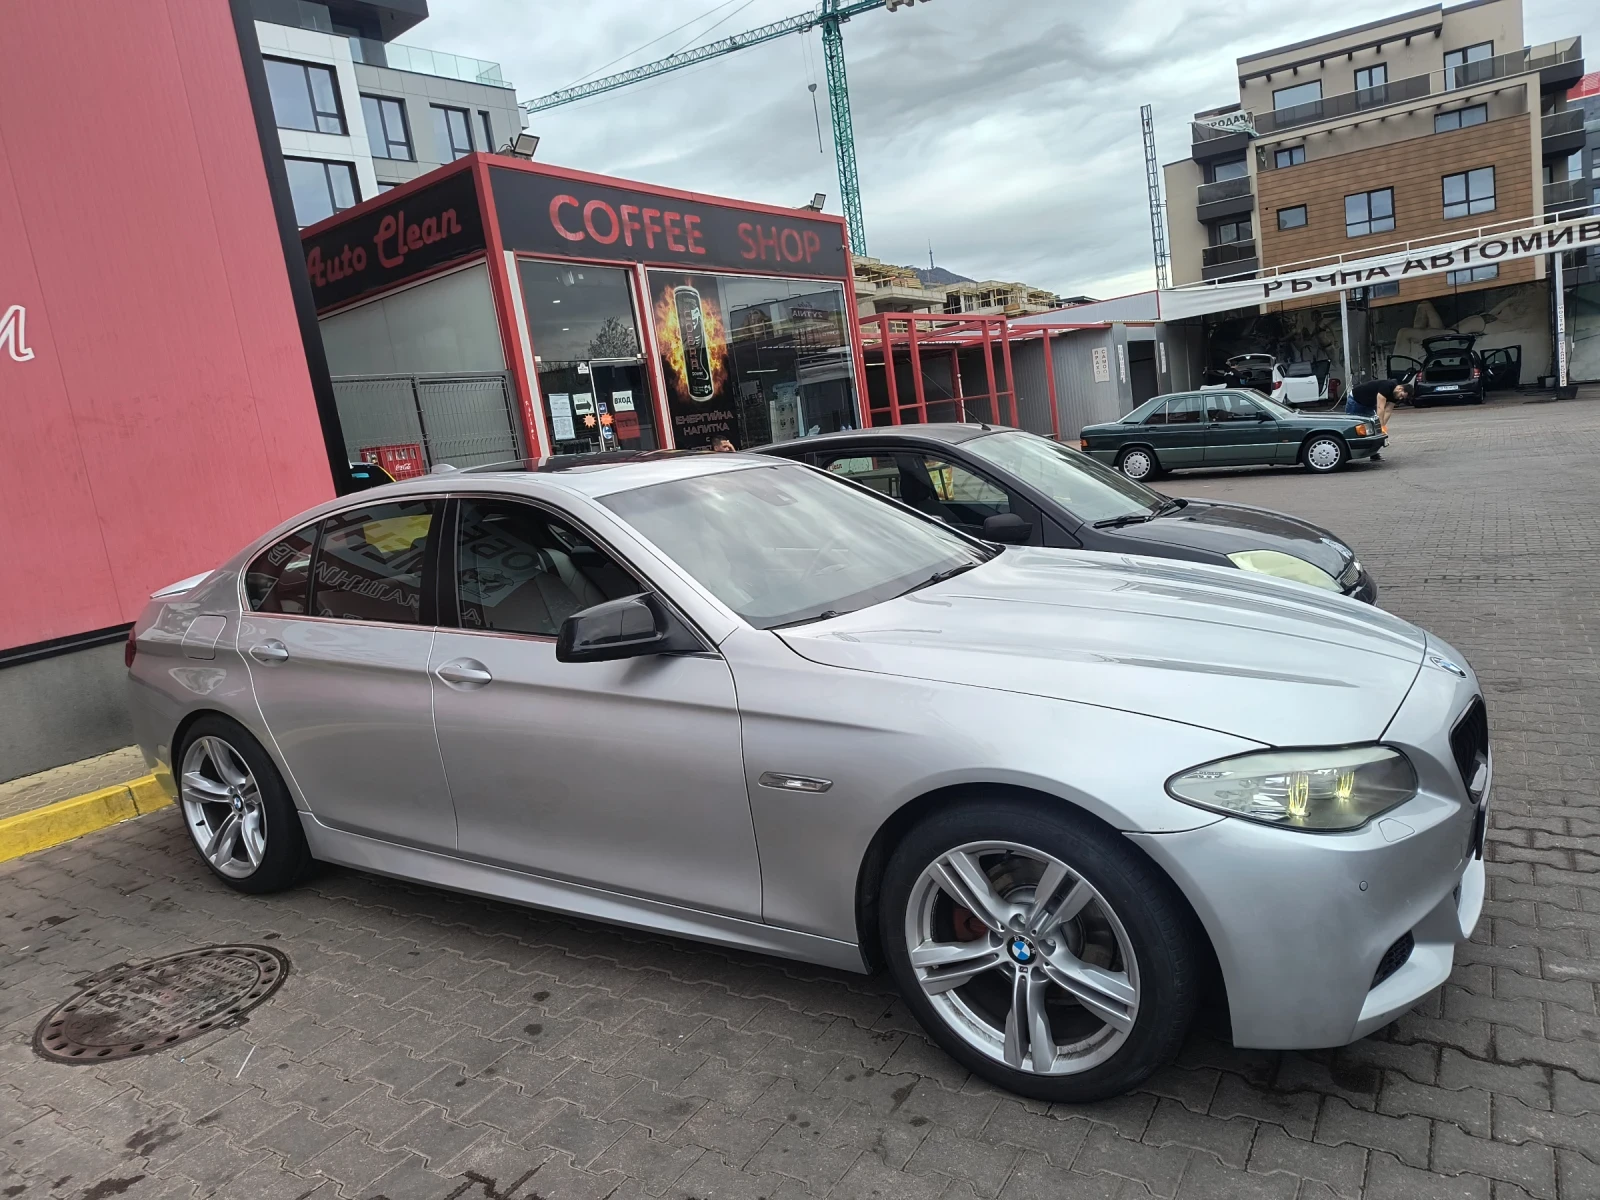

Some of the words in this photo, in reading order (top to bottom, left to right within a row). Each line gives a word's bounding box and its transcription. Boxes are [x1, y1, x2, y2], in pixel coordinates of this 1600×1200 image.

[550, 195, 706, 255] COFFEE
[738, 222, 821, 264] SHOP
[307, 246, 367, 287] Auto
[373, 208, 462, 268] Clean
[614, 396, 632, 405] ВХОД
[675, 410, 734, 425] ЕНЕРГИЙНА
[683, 422, 730, 436] НАПИТКА
[1013, 935, 1037, 955] BMW
